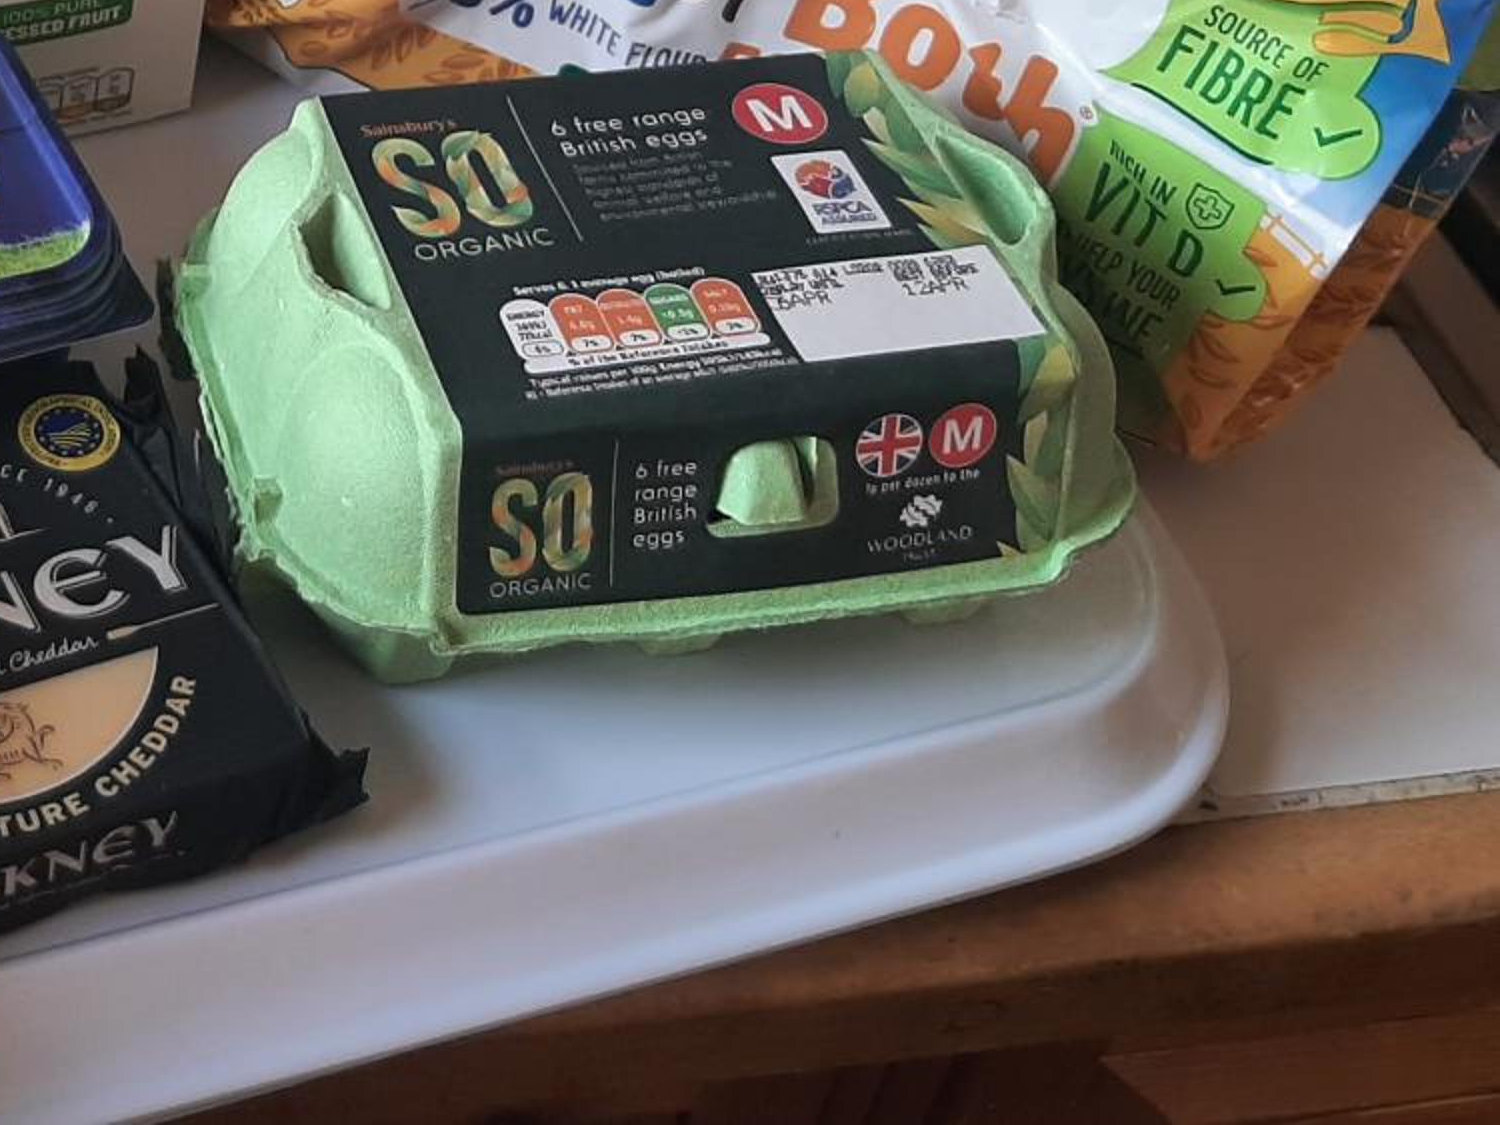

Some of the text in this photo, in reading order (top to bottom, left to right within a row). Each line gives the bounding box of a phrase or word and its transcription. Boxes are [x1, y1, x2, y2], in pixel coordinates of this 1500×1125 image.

[4, 5, 123, 41] ESSED FRUIT
[1203, 3, 1331, 83] SOURCE OF
[1156, 22, 1306, 141] FIBRE
[360, 119, 458, 138] Sainsbury's
[551, 107, 707, 137] 6 free range
[745, 94, 814, 133] M
[560, 128, 709, 158] British eggs
[371, 129, 534, 239] SO
[1110, 138, 1177, 206] RICH IN
[1084, 162, 1204, 278] VIT D
[414, 227, 555, 261] ORGANIC
[1126, 259, 1182, 311] YOUR
[941, 415, 984, 455] M
[635, 459, 698, 480] 6 free
[904, 474, 942, 489] dozen
[943, 470, 958, 483] to
[960, 468, 981, 481] the
[635, 482, 698, 503] range
[488, 471, 595, 579] SO
[634, 502, 698, 525] British
[632, 528, 685, 551] eggs
[866, 525, 973, 553] WOODLAND
[488, 572, 593, 599] ORGANIC
[7, 635, 100, 675] Cheddar
[95, 674, 197, 799] CHEDDAR
